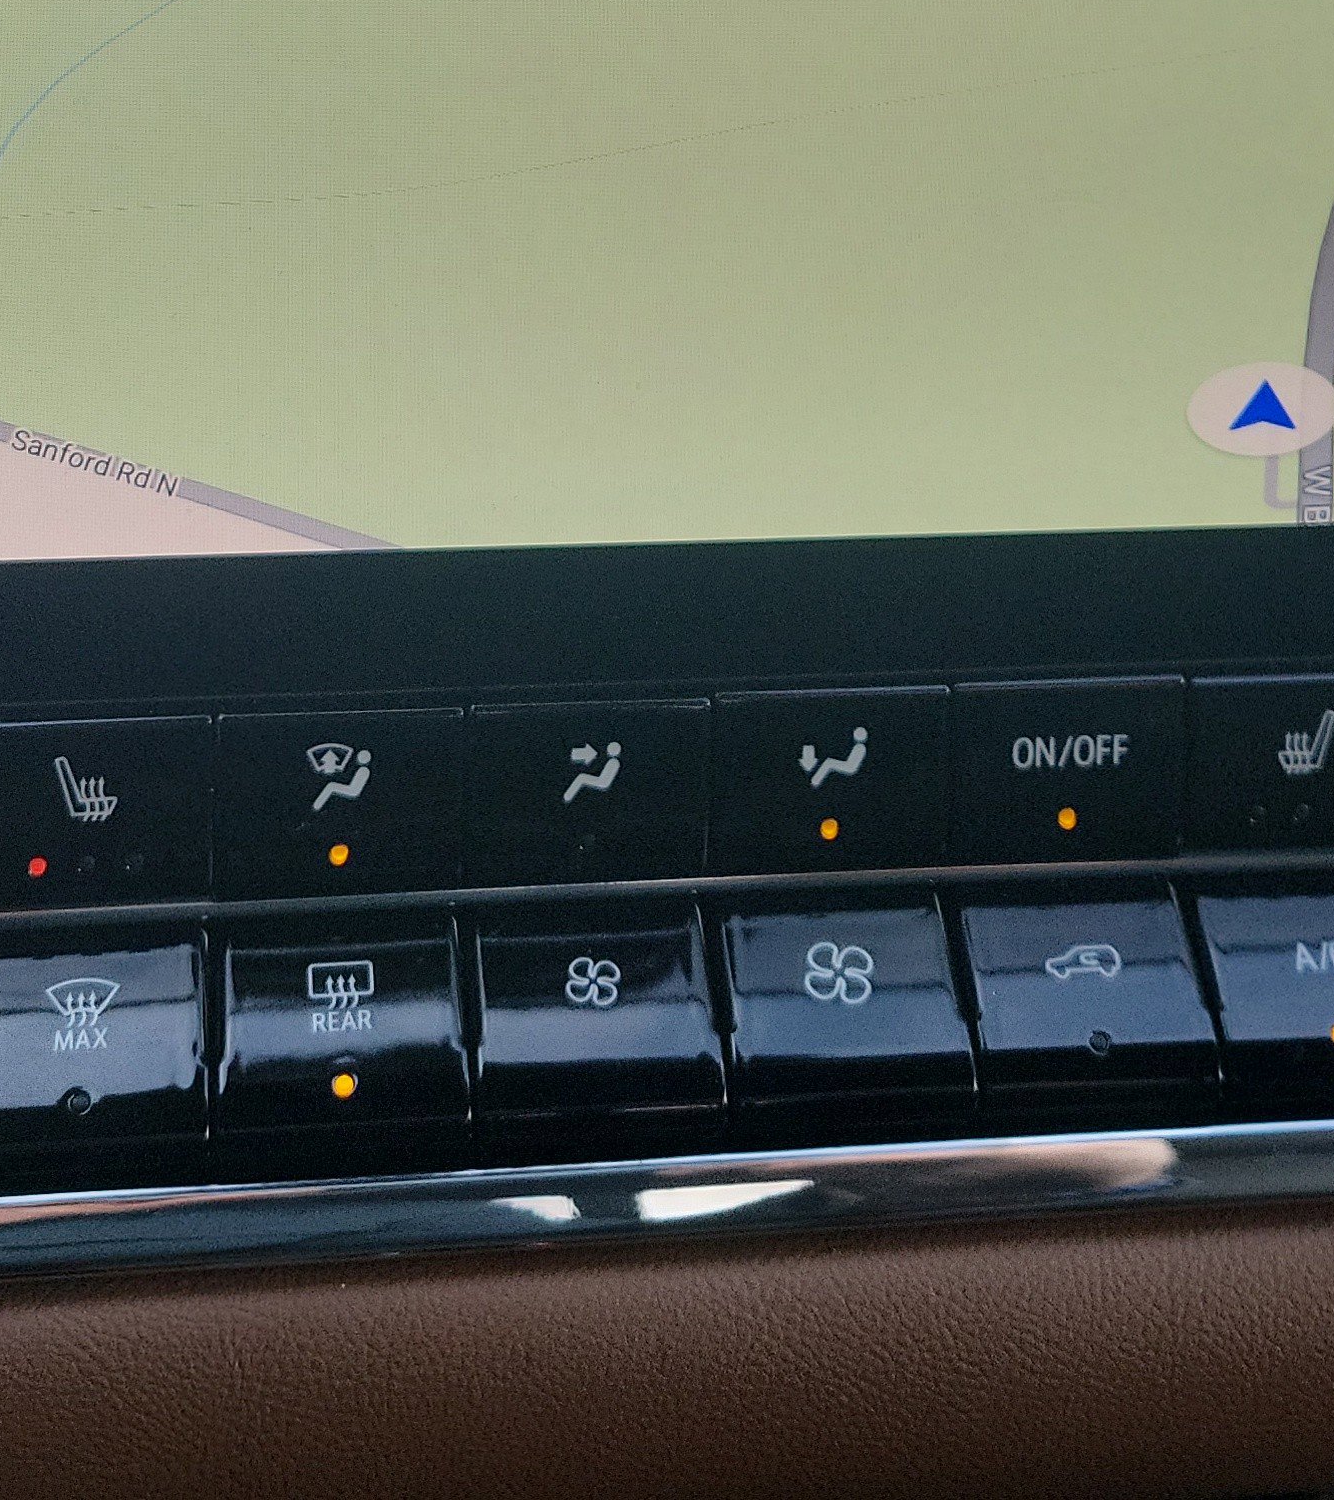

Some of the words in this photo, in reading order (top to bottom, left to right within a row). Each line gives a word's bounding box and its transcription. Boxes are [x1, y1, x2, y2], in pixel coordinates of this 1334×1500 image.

[11, 429, 113, 477] Sanford
[116, 461, 153, 489] Rd
[155, 472, 179, 497] N
[1303, 465, 1332, 496] W
[1011, 733, 1129, 769] ON/OFF
[312, 1009, 373, 1033] REAR
[54, 1027, 108, 1051] MAX
